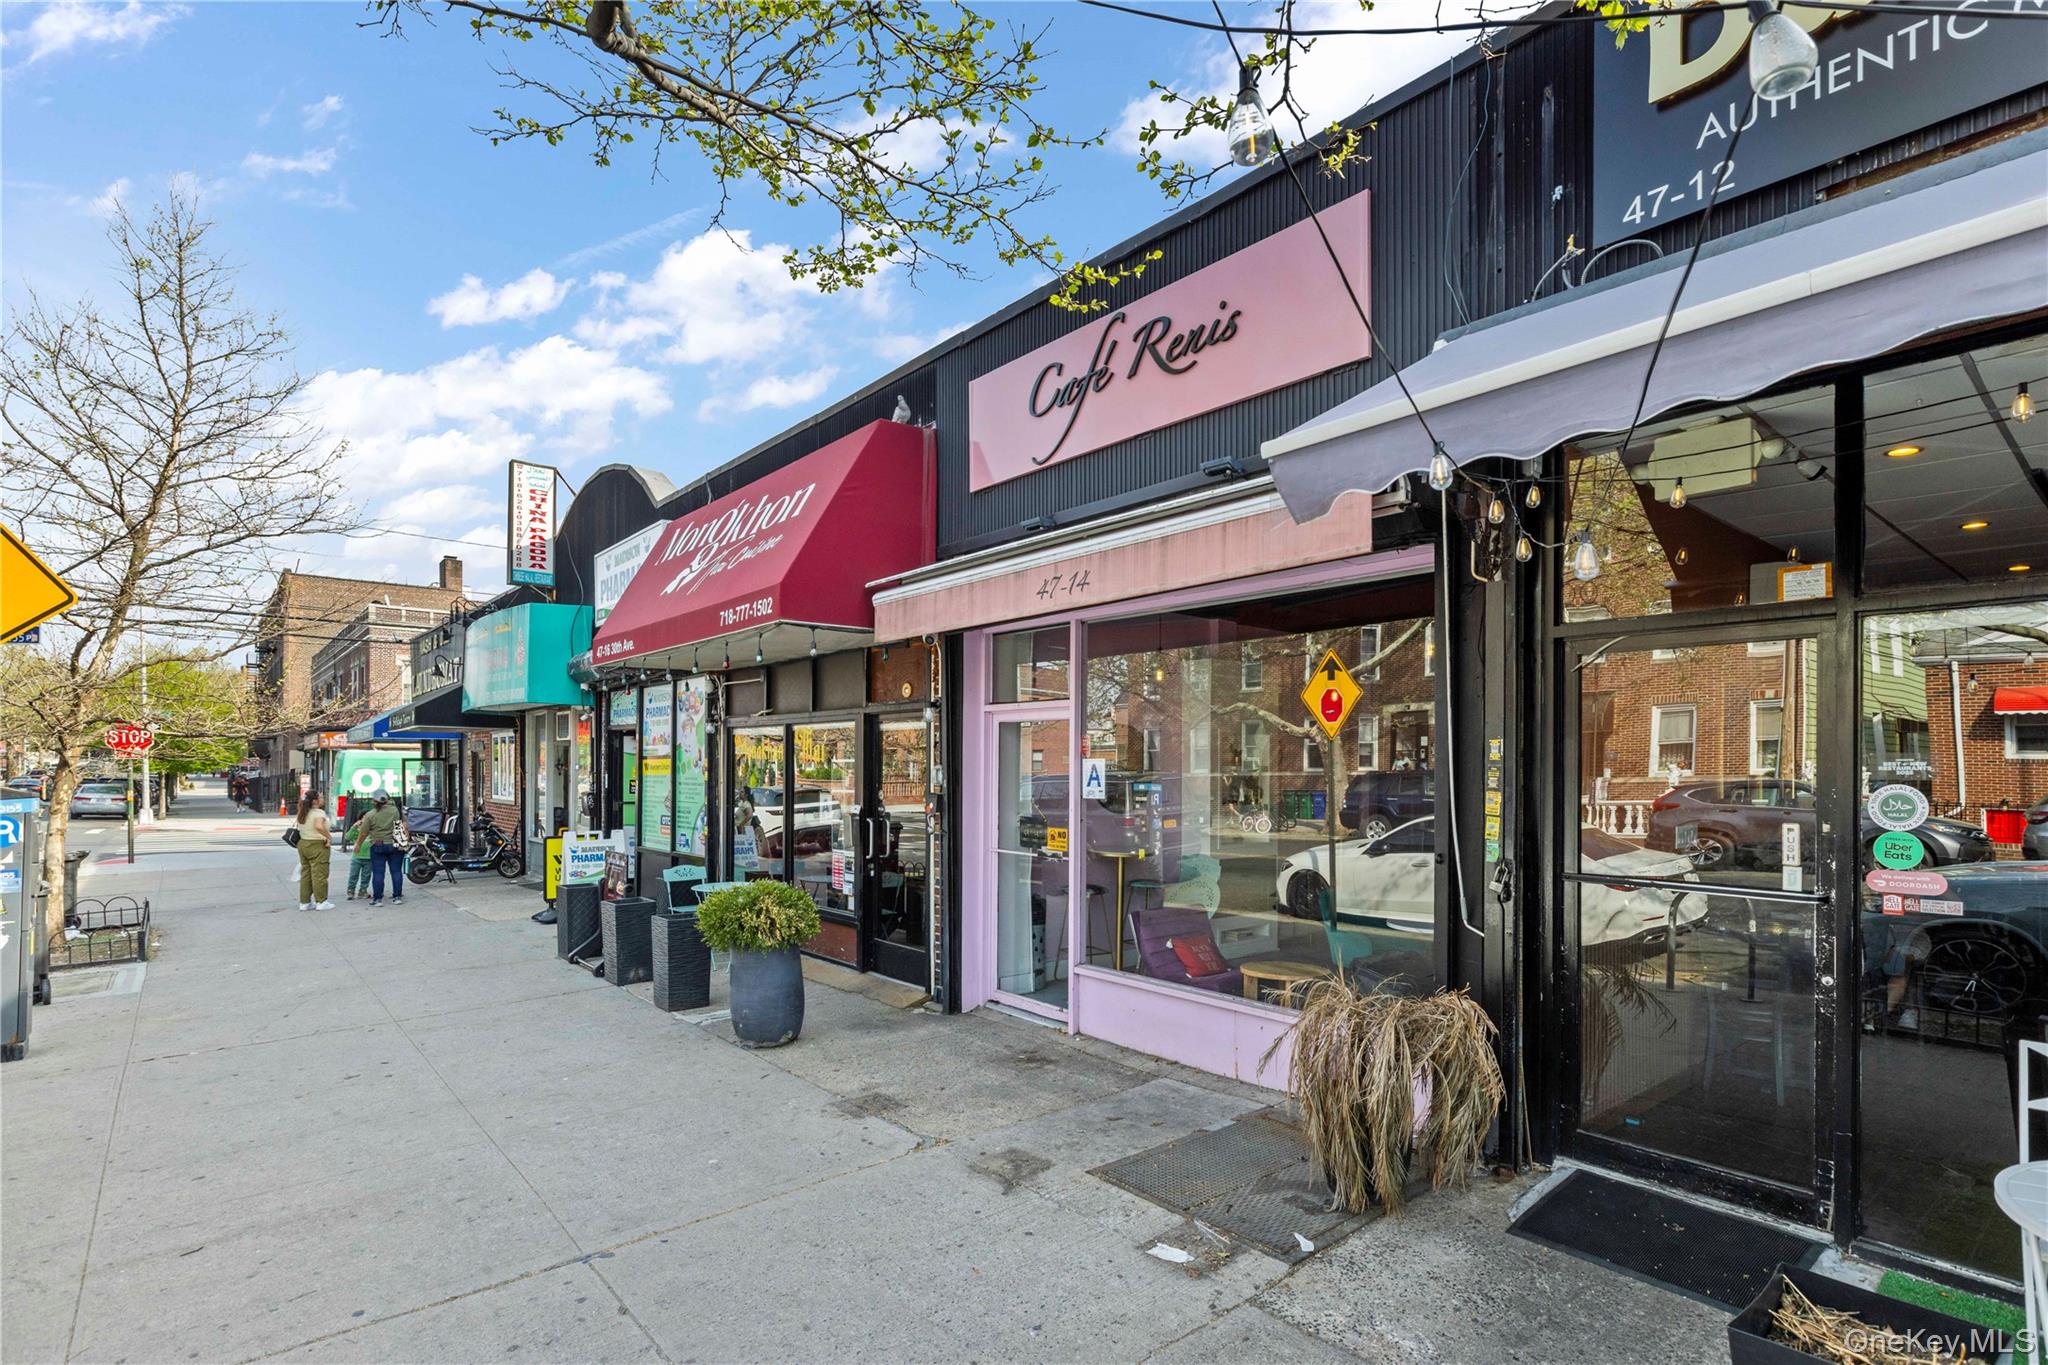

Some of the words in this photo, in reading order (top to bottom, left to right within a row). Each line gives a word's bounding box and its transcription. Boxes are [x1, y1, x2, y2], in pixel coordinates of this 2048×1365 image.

[1622, 160, 1736, 225] 47-12
[1126, 300, 1243, 379] Renis
[528, 488, 548, 524] CHINA
[528, 527, 547, 570] PAGODA
[1036, 569, 1090, 600] 47-14
[719, 596, 773, 627] 718-777-1502
[109, 729, 151, 744] STOP
[1086, 763, 1102, 787] A
[1057, 831, 1067, 839] NO
[1786, 827, 1796, 862] PUSH
[1885, 842, 1913, 852] Uber
[571, 853, 606, 863] PHARM
[1884, 851, 1913, 861] Eats
[1889, 881, 1941, 890] DOORDASH
